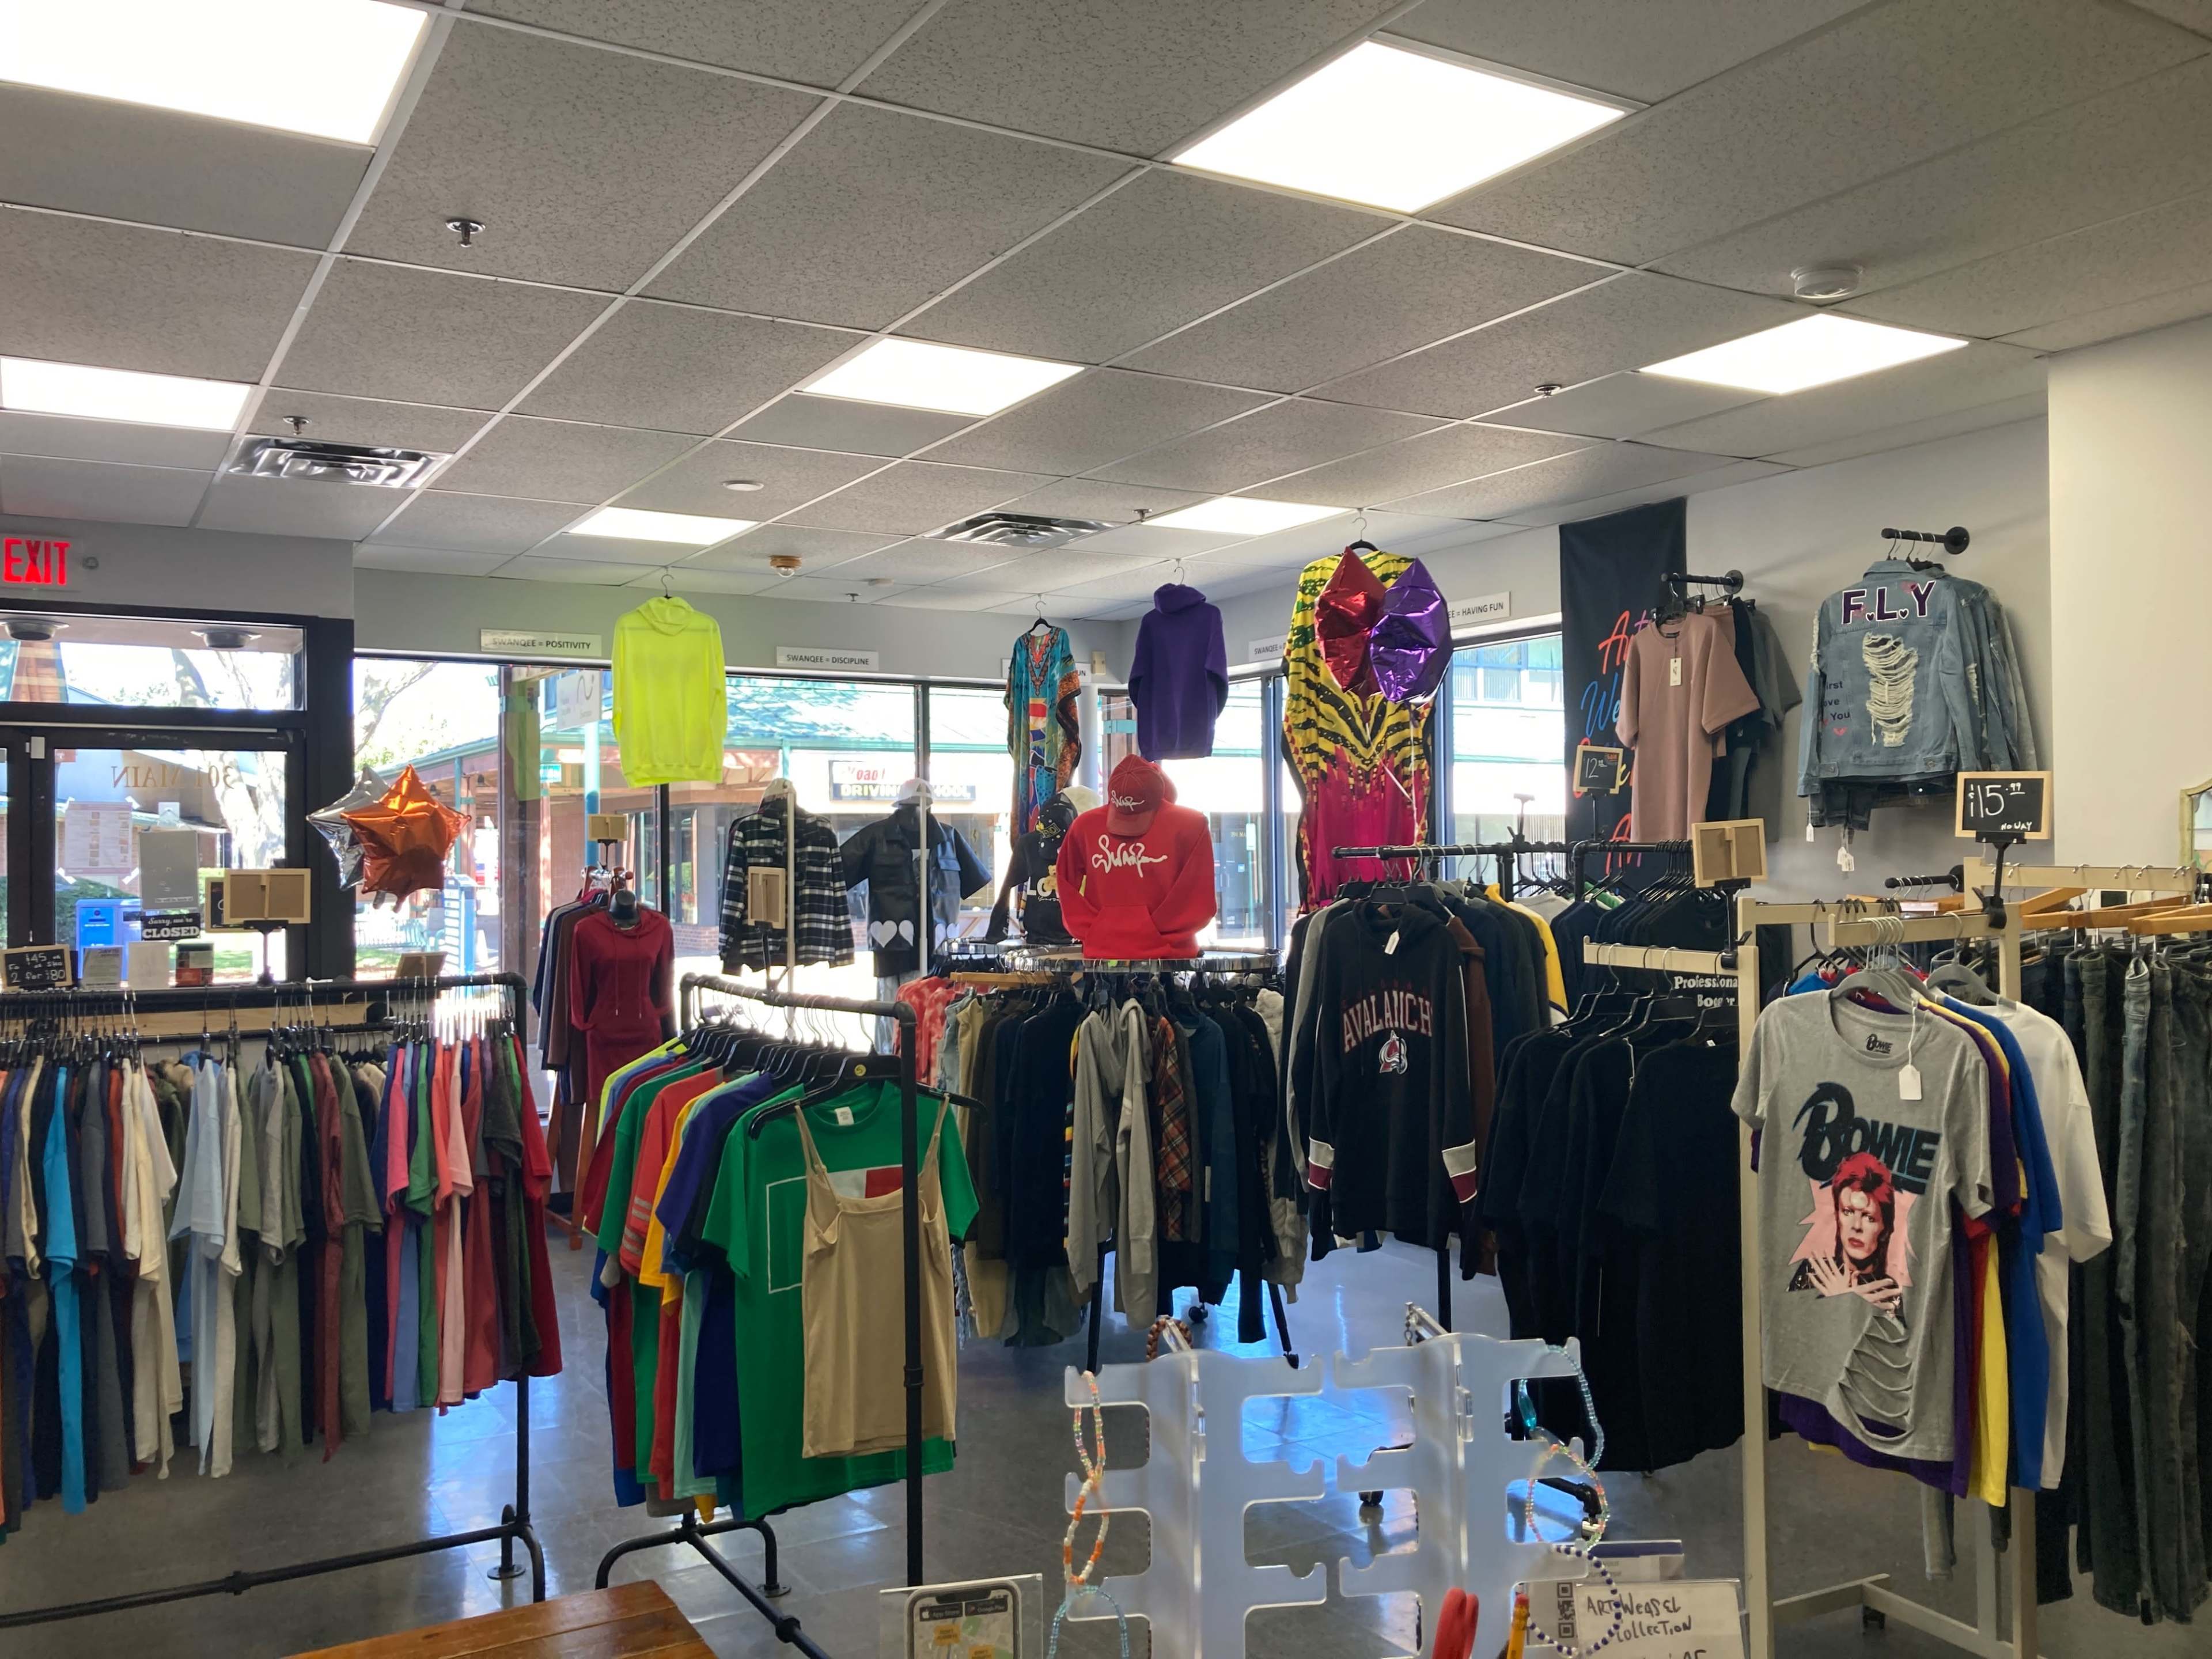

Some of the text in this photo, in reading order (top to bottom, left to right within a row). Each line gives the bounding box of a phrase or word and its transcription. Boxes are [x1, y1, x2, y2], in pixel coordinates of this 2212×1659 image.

[4, 537, 71, 585] EXIT
[1462, 604, 1488, 616] HAVING
[1489, 602, 1504, 611] FUN
[546, 639, 591, 649] POSITIVITY
[786, 654, 824, 663] SWANQEE
[831, 656, 870, 665] DISCIPLINE
[1825, 680, 1843, 690] irst
[1823, 698, 1840, 708] ove
[1830, 711, 1851, 721] You
[840, 784, 901, 797] DRIVIN
[2014, 821, 2032, 831] WAY
[142, 926, 200, 938] CLOSED
[1674, 975, 1738, 990] Professiona
[1342, 990, 1434, 1054] AVALANCH
[1792, 1081, 1942, 1195] BOWIE
